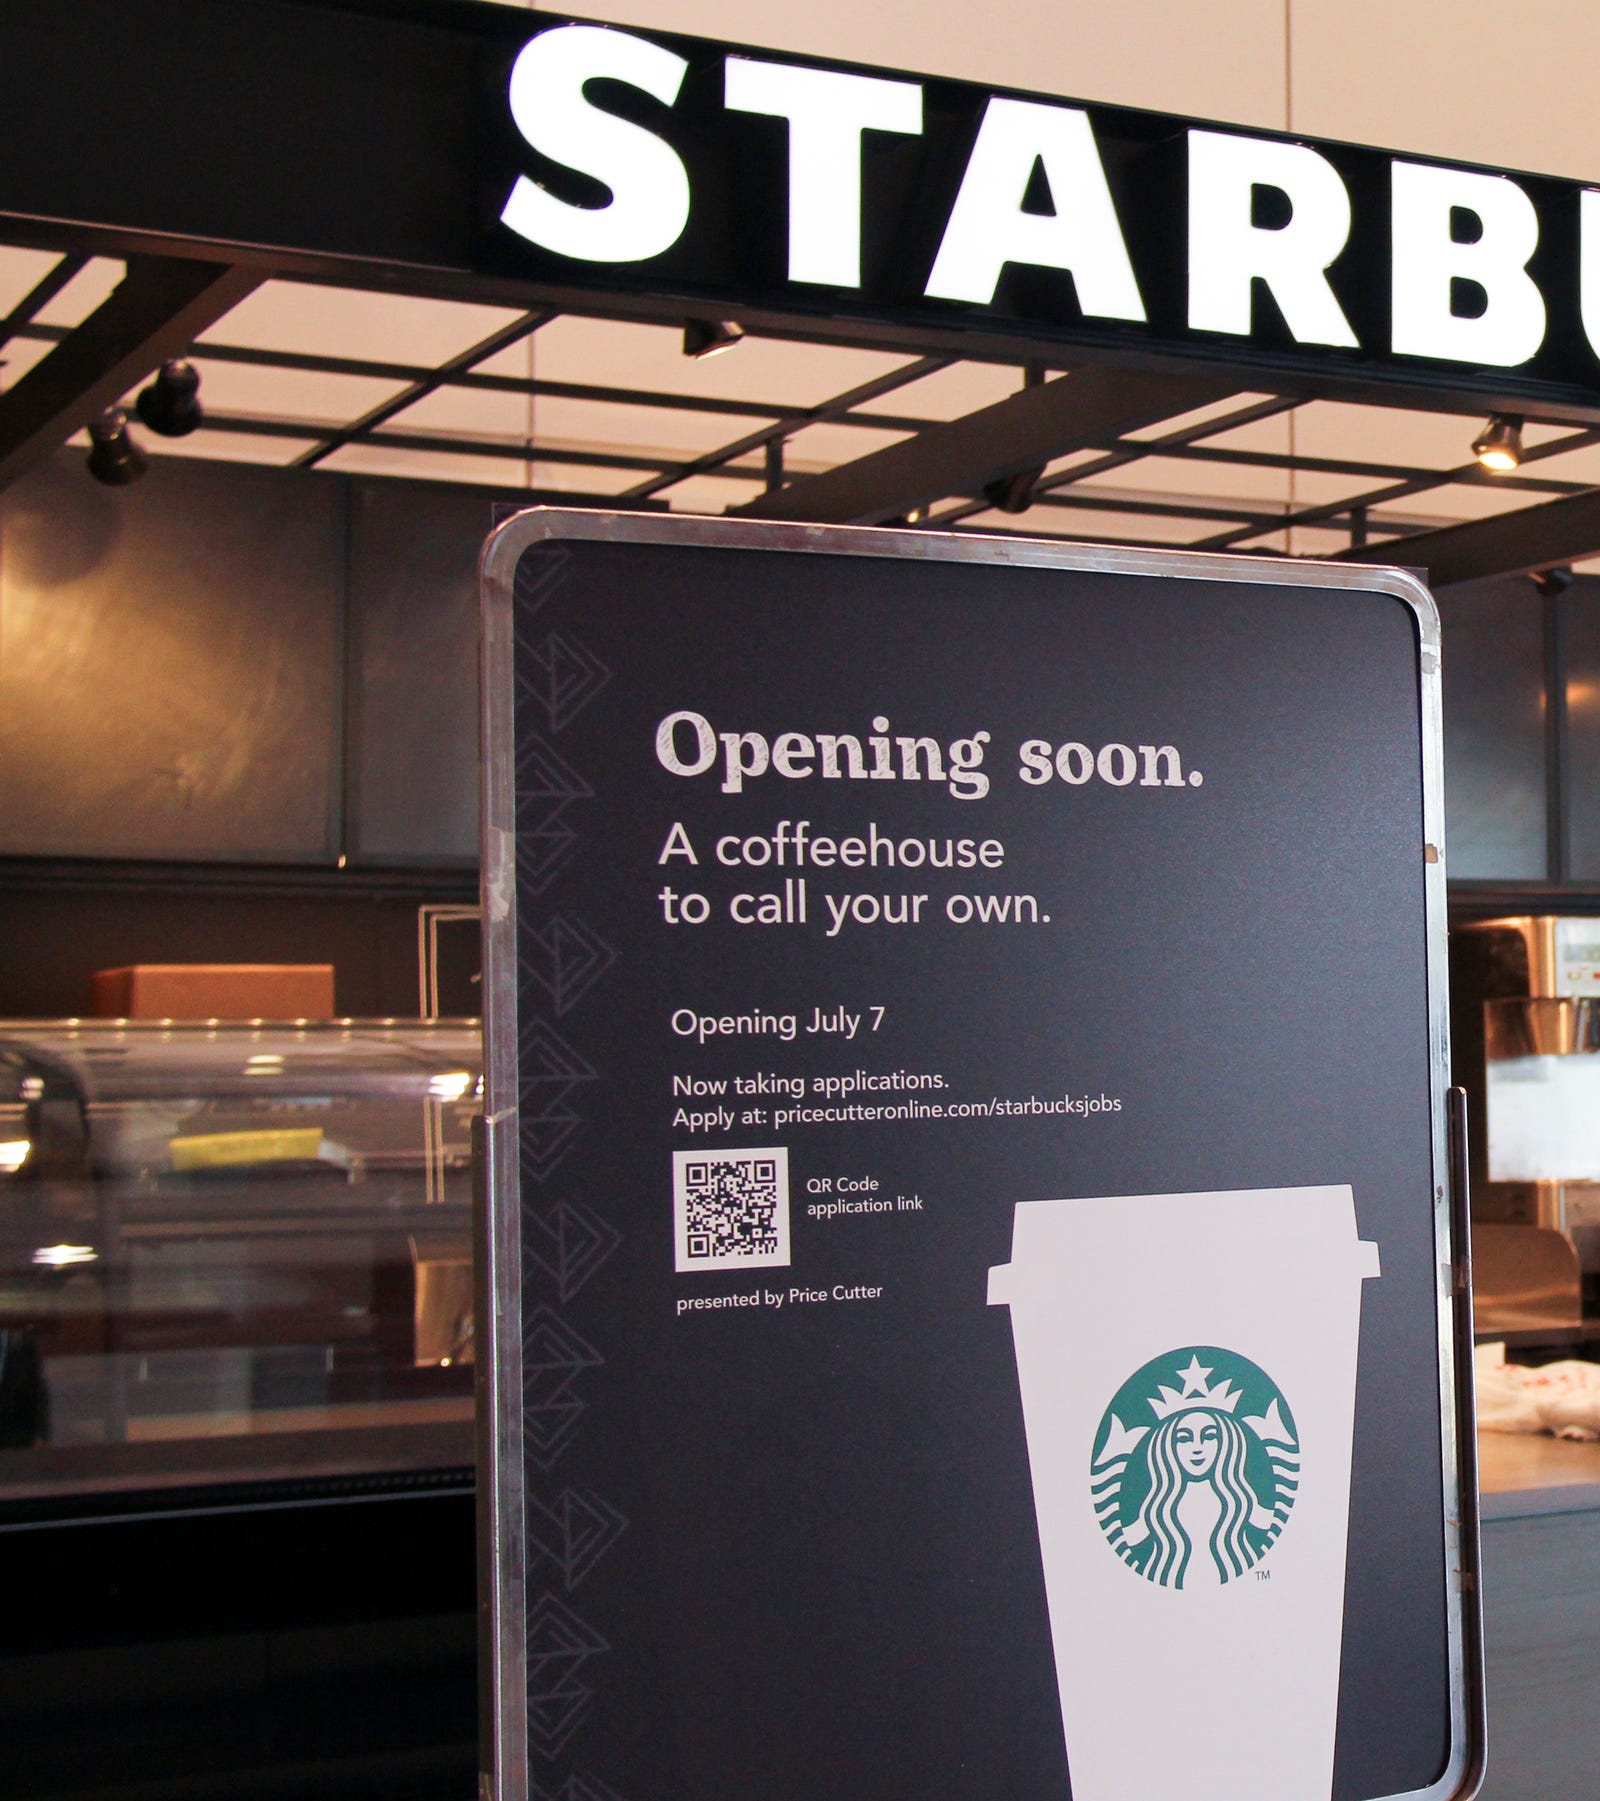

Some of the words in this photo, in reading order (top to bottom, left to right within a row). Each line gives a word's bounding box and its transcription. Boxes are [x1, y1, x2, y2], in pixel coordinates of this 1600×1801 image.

[655, 710, 991, 801] Opening
[1018, 739, 1204, 788] soon.
[658, 822, 699, 865] A
[716, 820, 1005, 869] coffeehouse
[658, 886, 711, 924] to
[730, 878, 807, 924] call
[824, 894, 929, 937] your
[946, 894, 1051, 924] own.
[671, 1008, 797, 1045] Opening
[805, 1005, 861, 1040] July
[869, 1006, 885, 1031] 7
[673, 1075, 728, 1097] Now
[733, 1071, 805, 1099] taking
[812, 1069, 949, 1097] applications.
[672, 1105, 735, 1133] Apply
[741, 1107, 767, 1125] at:
[774, 1092, 1122, 1129] pricecutteronline.com/starbucksjobs
[806, 1178, 832, 1194] QR
[836, 1175, 880, 1192] Code
[807, 1197, 893, 1220] application
[897, 1194, 923, 1211] link
[676, 1292, 760, 1316] presented
[764, 1289, 785, 1309] by
[789, 1287, 828, 1303] Price
[832, 1285, 884, 1301] Cutter
[1254, 1569, 1272, 1582] TM
